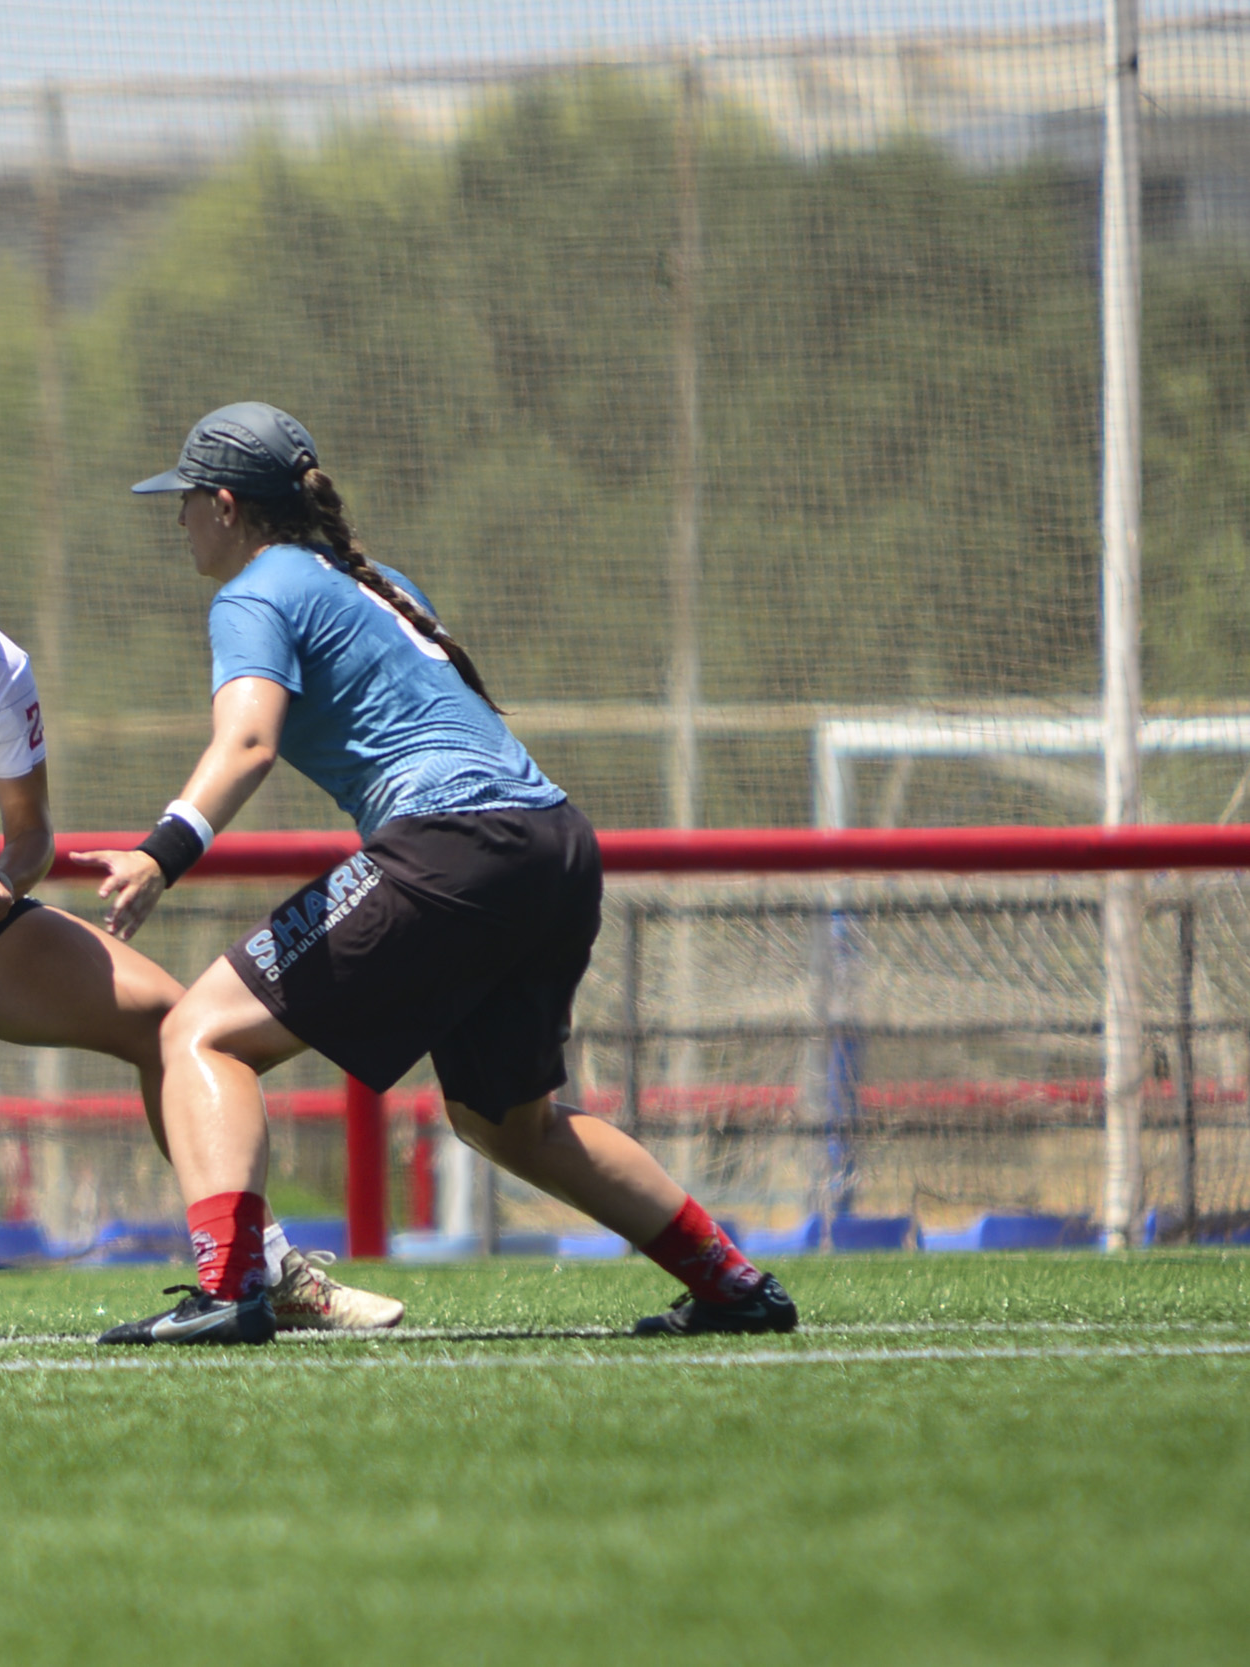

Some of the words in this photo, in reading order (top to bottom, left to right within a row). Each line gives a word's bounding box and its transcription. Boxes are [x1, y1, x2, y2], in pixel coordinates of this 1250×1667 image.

[25, 701, 44, 751] 2
[264, 949, 299, 982] CLUB
[296, 902, 352, 954] ULTIMATE
